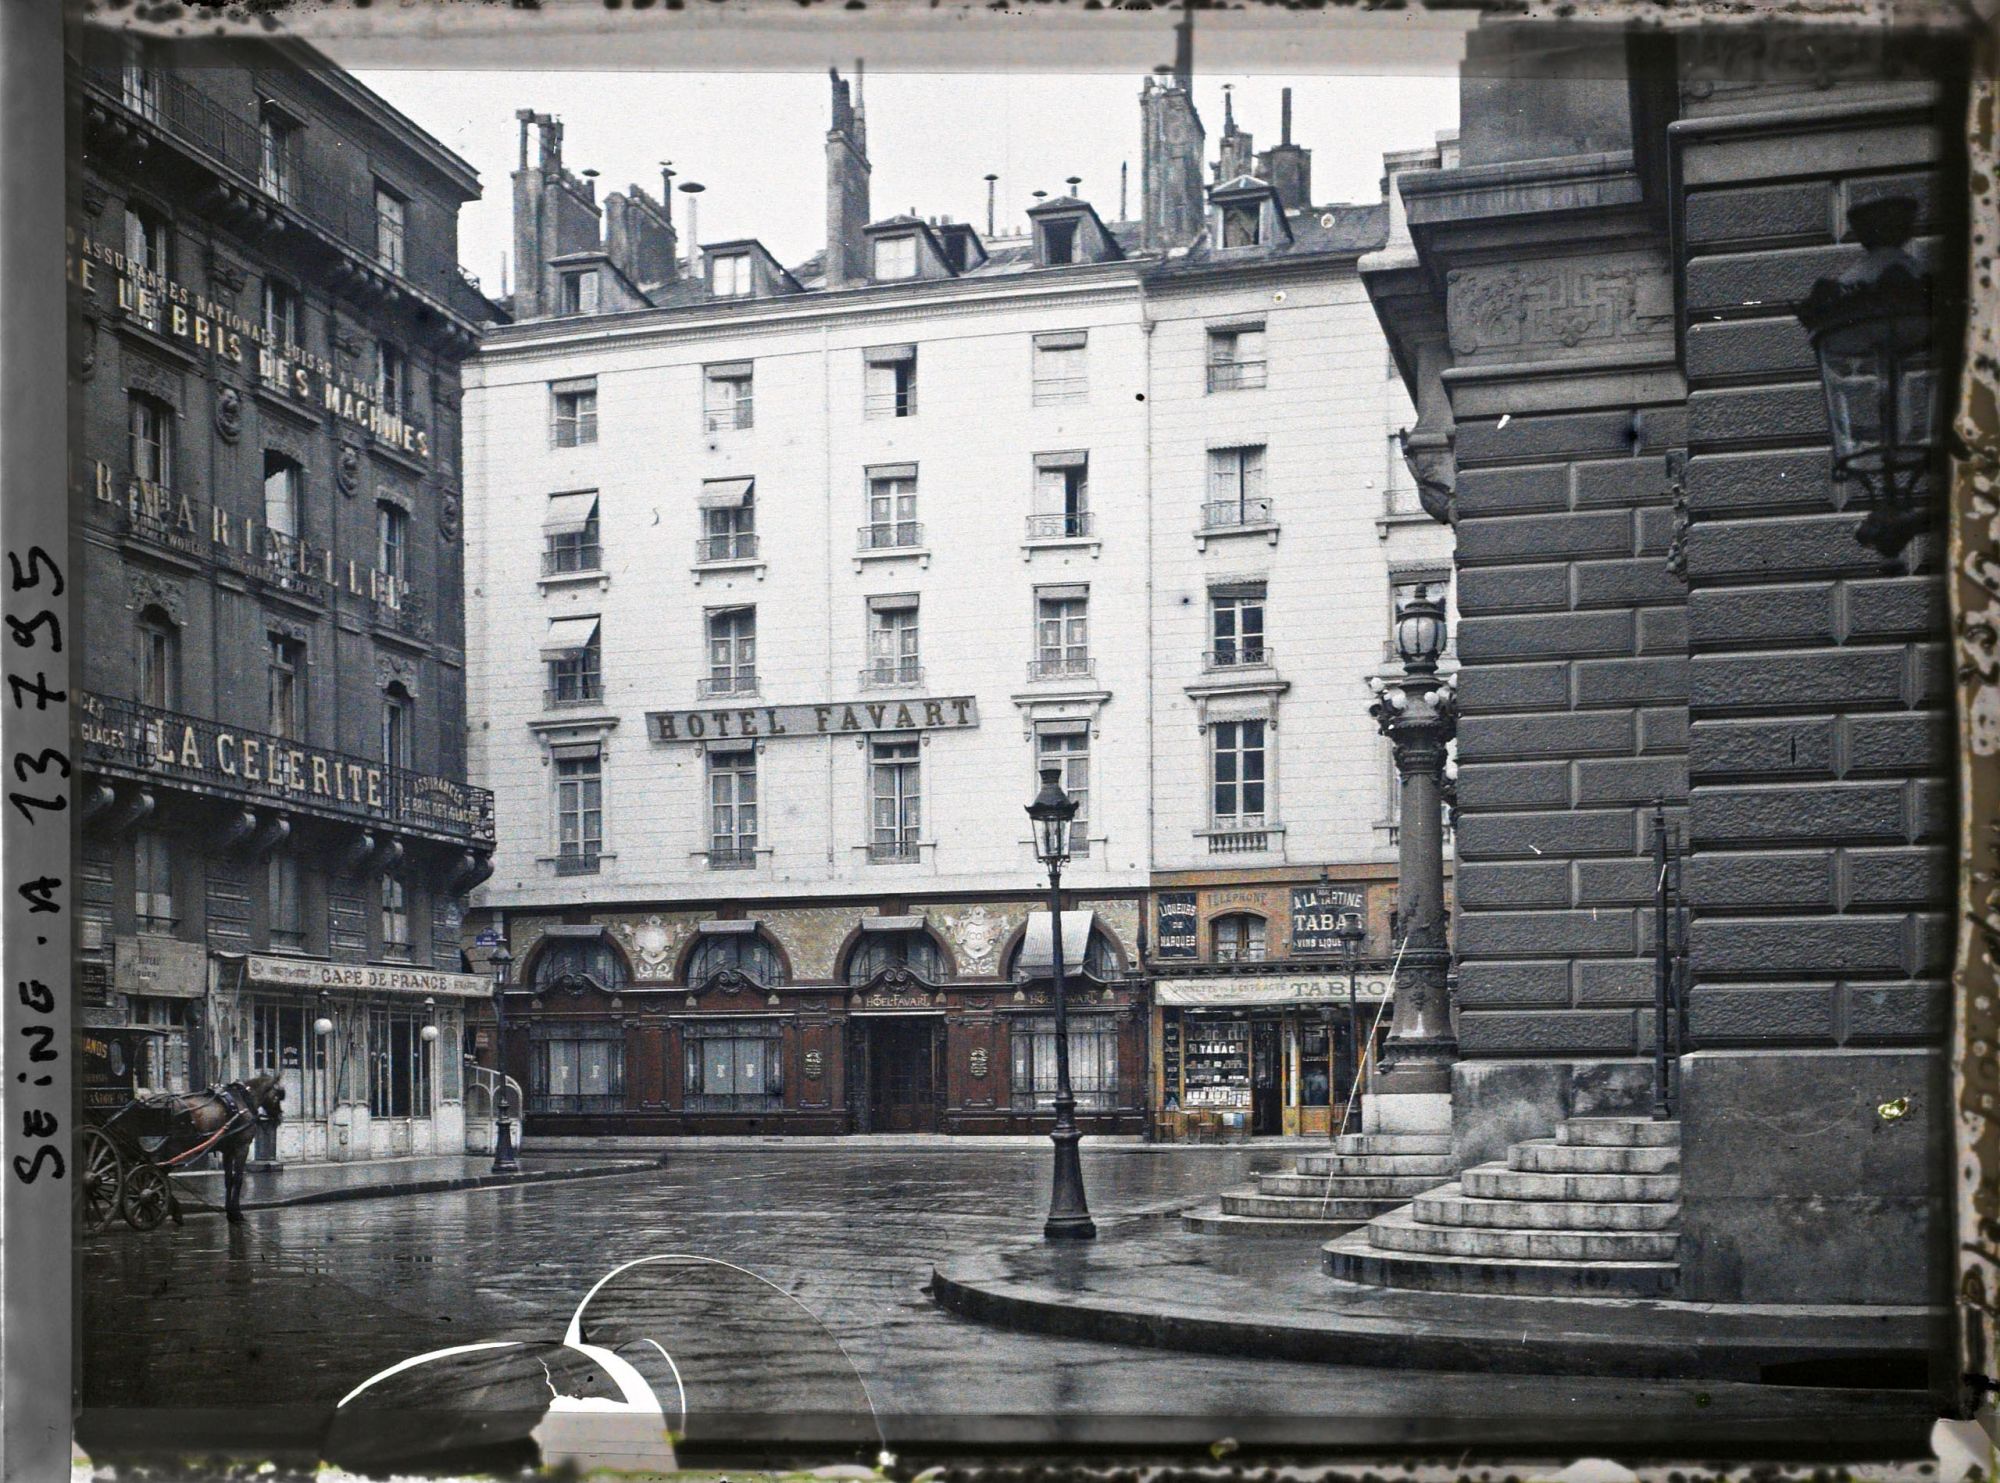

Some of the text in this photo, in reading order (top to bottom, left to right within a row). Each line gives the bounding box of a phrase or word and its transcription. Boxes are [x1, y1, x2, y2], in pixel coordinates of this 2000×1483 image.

[83, 237, 188, 304] ASSURANCES
[119, 277, 153, 320] LE
[173, 304, 243, 364] BRIS
[260, 350, 309, 397] DES
[325, 382, 428, 457] MACHINES
[655, 700, 970, 740] HOTEL FAVART
[81, 723, 125, 749] GLACES
[155, 718, 382, 807] LA CELERITE
[413, 776, 464, 806] ASSURANCES
[1160, 904, 1197, 917] LIQUEURS
[1160, 935, 1196, 947] MARQUES
[368, 969, 387, 988] DE
[391, 971, 448, 991] FRANCE
[1200, 1044, 1236, 1054] TABAC
